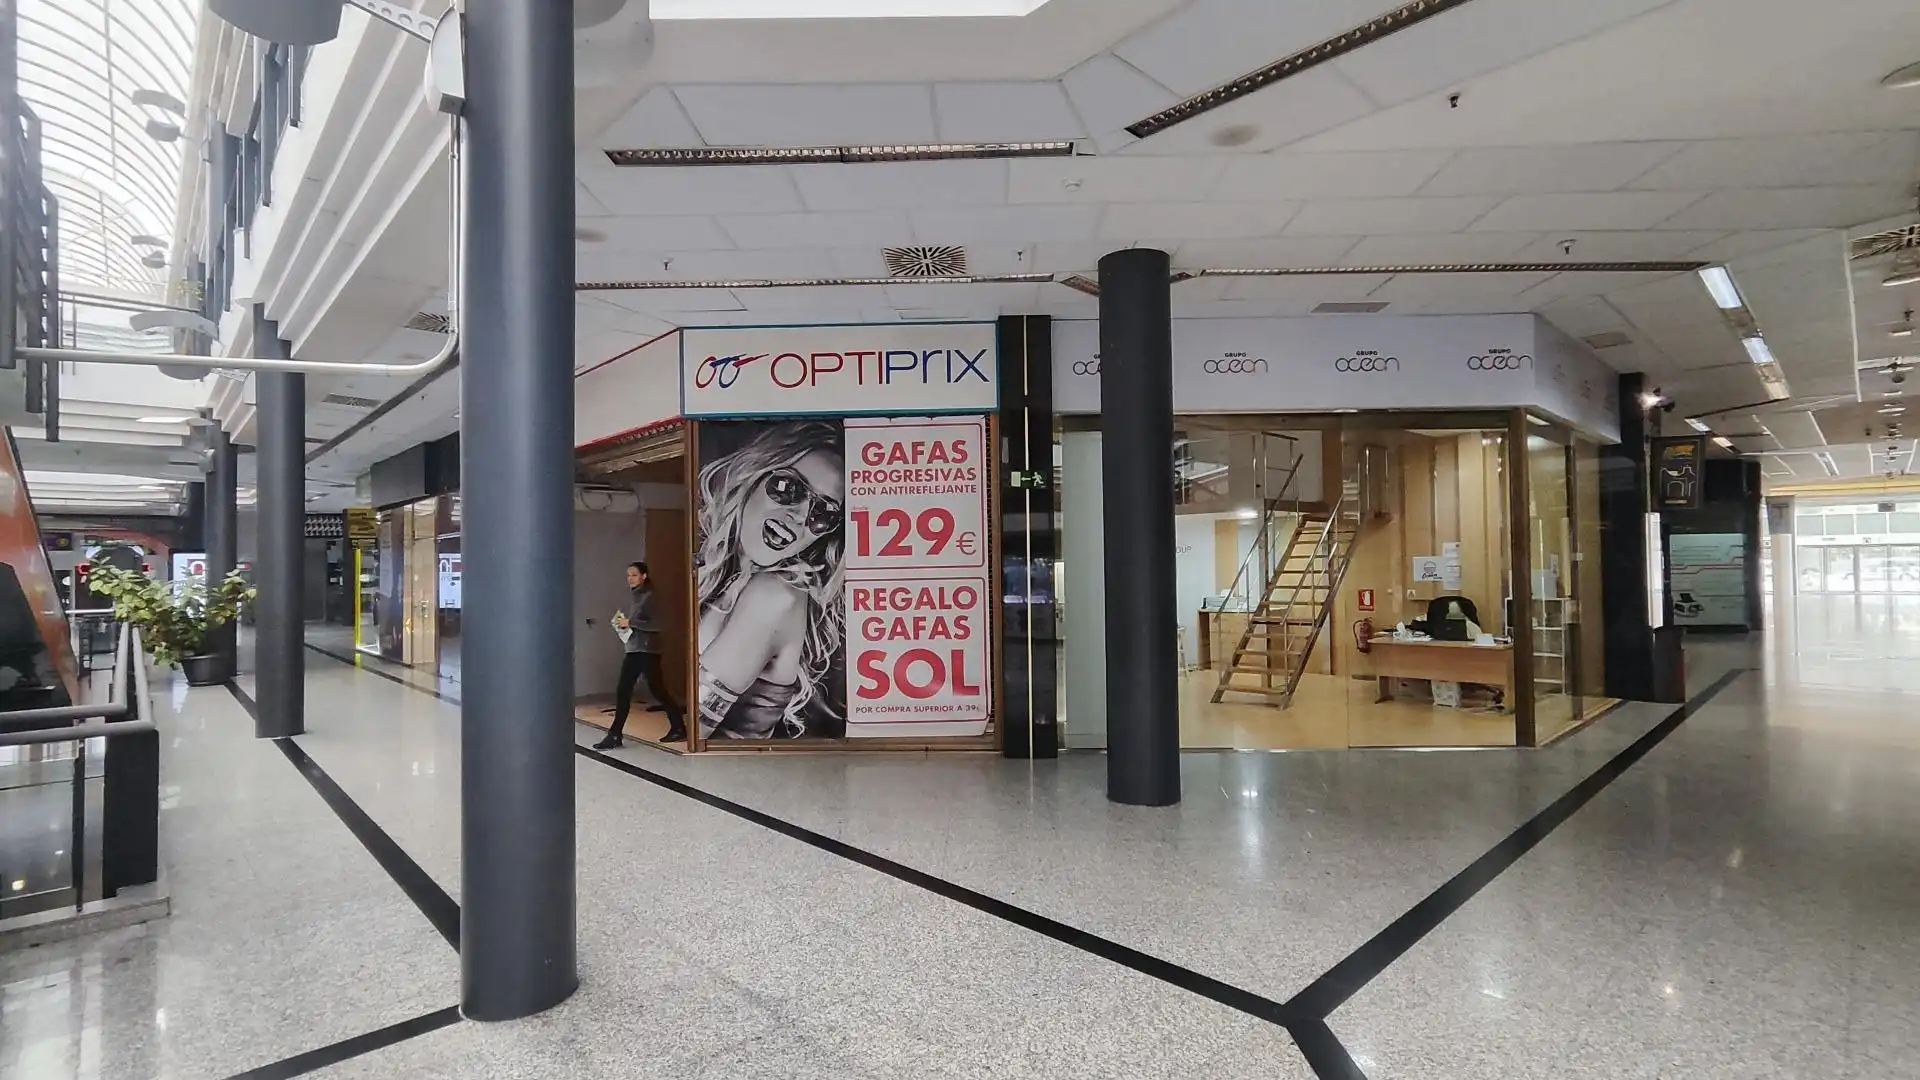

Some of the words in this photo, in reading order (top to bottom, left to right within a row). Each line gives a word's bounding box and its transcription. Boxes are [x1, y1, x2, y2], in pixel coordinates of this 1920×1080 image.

[861, 440, 968, 467] GAFAS
[851, 467, 977, 484] PROGRESIVAS
[851, 486, 876, 496] CON
[880, 484, 977, 496] ANTIREFLEJANTE
[850, 507, 977, 557] 129€
[1176, 545, 1192, 554] OUP
[853, 586, 978, 612] REGALO
[861, 615, 971, 642] GAFAS
[856, 648, 980, 700] SOL
[855, 705, 874, 714] POR
[876, 705, 912, 713] COMPRA
[914, 704, 954, 713] SUPERIOR
[957, 704, 963, 712] A
